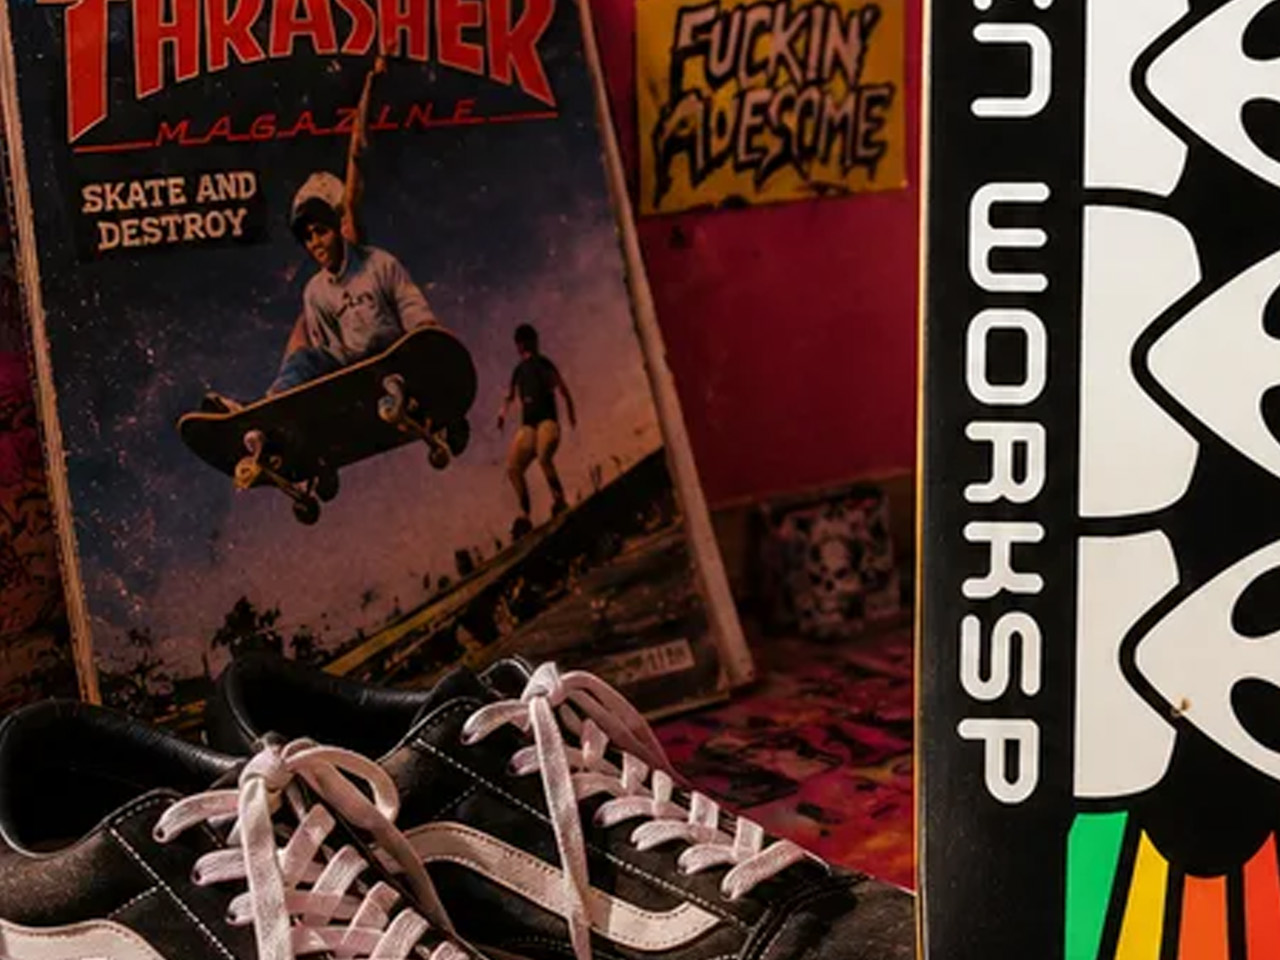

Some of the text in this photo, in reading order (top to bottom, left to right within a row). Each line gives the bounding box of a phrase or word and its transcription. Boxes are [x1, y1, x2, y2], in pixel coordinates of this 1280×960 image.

[156, 98, 478, 145] MAGAZINE
[81, 170, 257, 214] SKATE AND
[97, 207, 249, 251] DESTROY
[957, 181, 1051, 805] WORKSP
